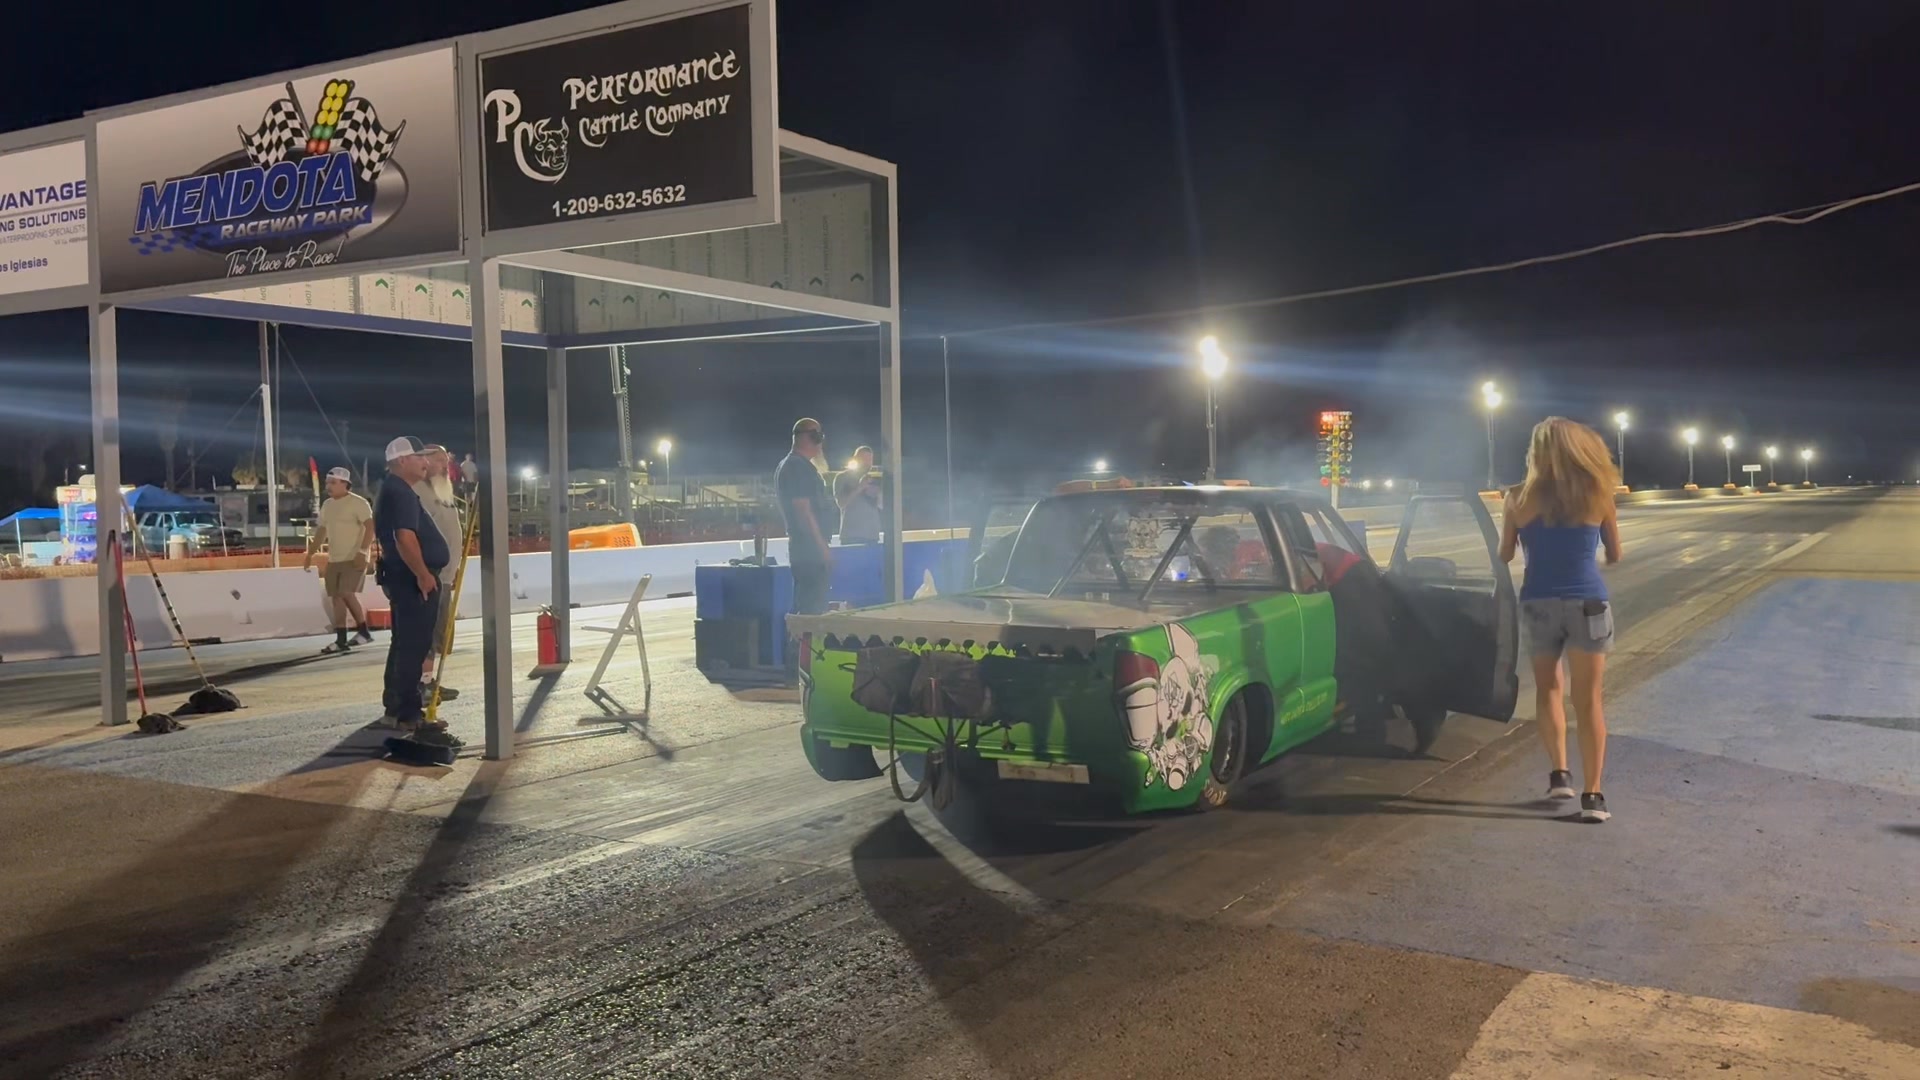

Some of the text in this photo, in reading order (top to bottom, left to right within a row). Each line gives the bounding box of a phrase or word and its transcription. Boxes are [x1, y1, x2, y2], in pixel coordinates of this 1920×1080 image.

[134, 150, 357, 235] MENDOTA
[552, 184, 686, 217] 1-209-632-5632
[19, 208, 86, 229] SOLUTIONS
[220, 204, 369, 241] RACEWAY PARK
[10, 256, 48, 273] Iglesias
[225, 239, 344, 279] The Place to Race!
